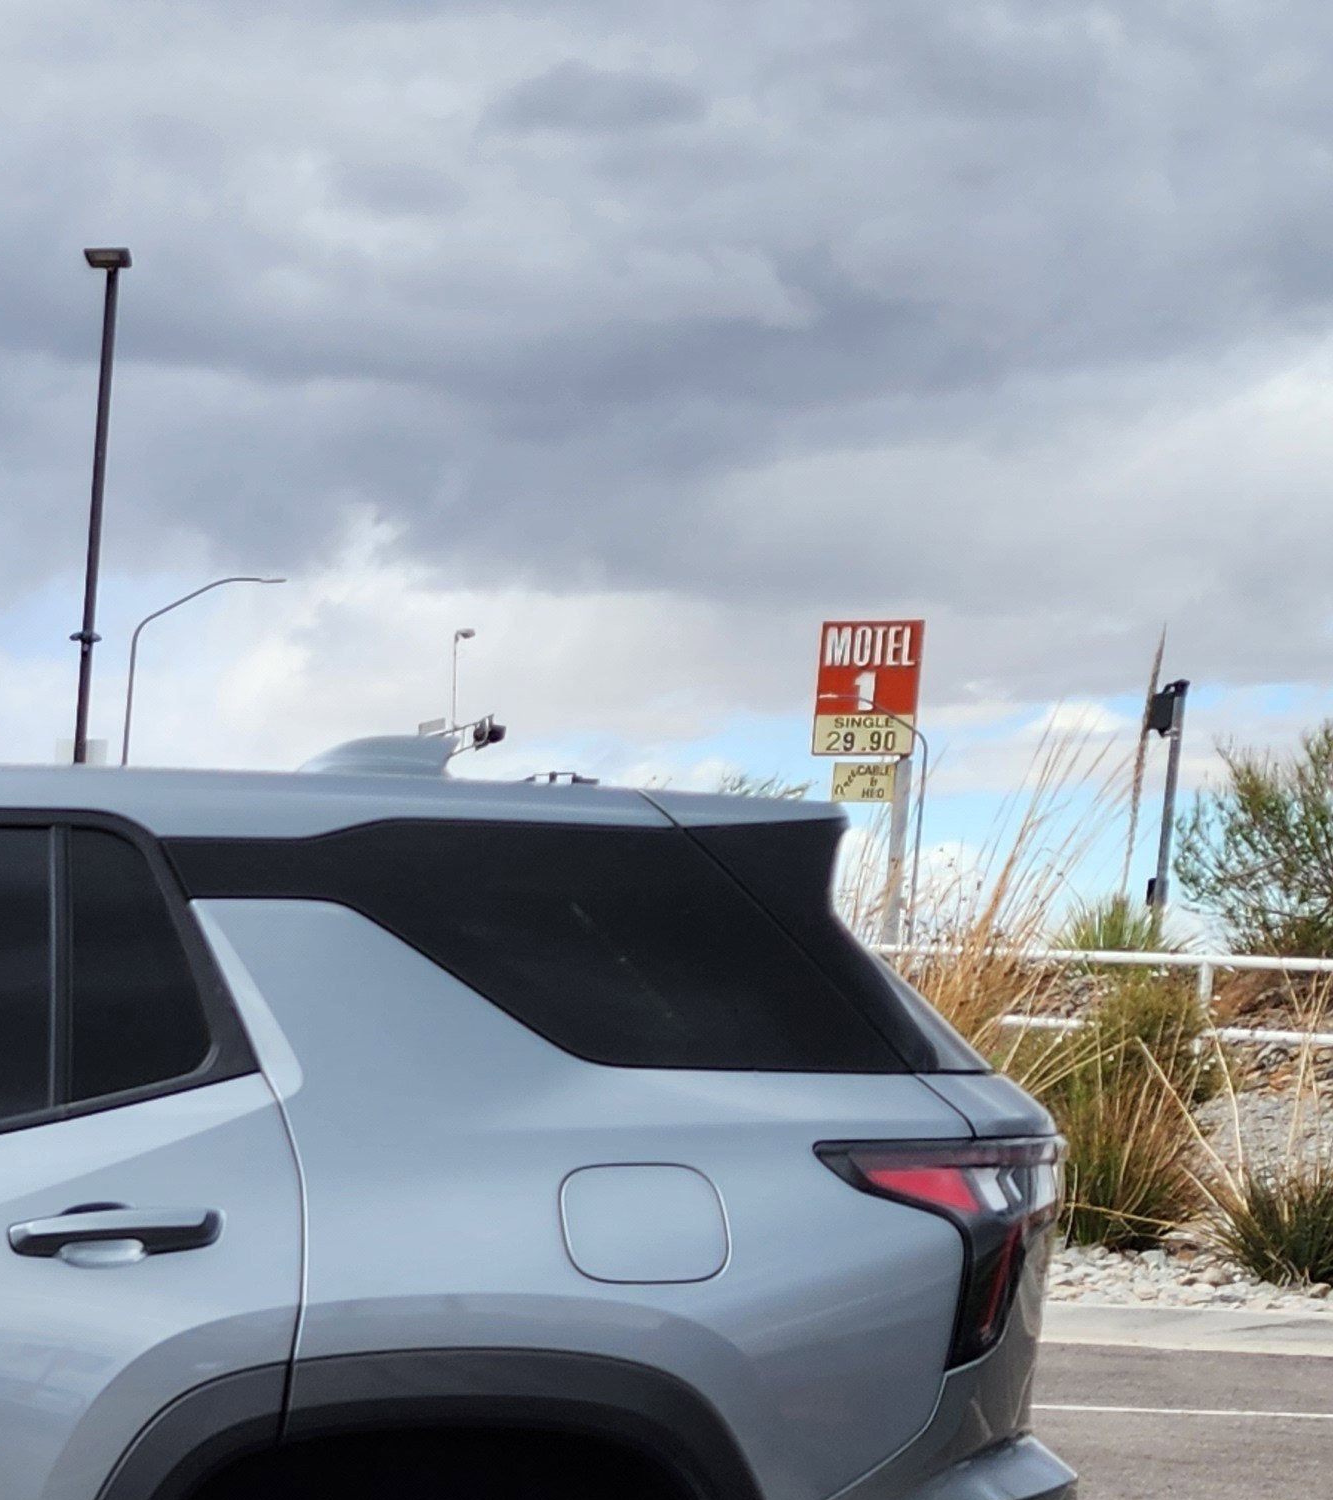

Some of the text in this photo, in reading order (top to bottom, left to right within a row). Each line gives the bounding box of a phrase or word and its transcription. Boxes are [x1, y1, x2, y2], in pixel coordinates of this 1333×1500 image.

[825, 625, 915, 667] MOTEL
[854, 671, 876, 712] 1
[834, 717, 894, 729] SINGLE
[826, 731, 896, 751] 29.90
